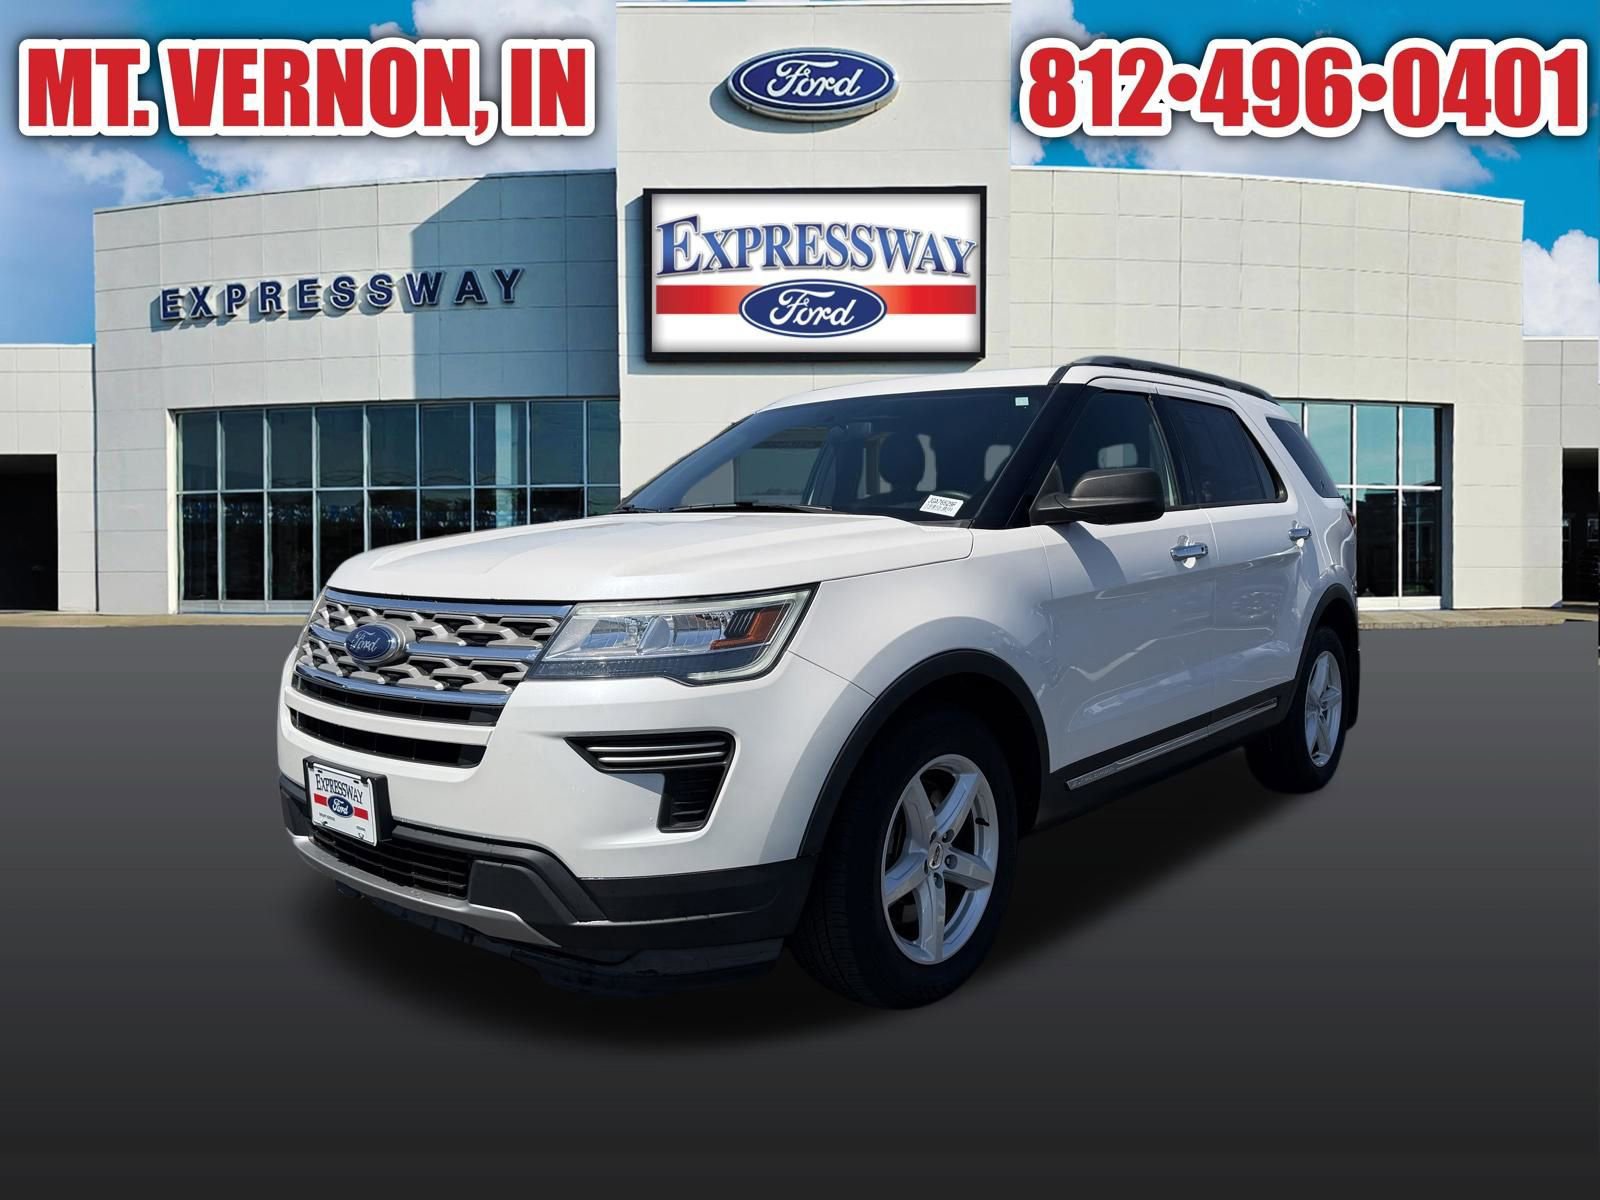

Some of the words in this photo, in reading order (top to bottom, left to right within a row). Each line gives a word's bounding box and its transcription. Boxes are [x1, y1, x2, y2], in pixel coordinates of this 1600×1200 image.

[767, 60, 863, 97] Ford
[656, 215, 976, 277] EXPRESSWAY
[160, 268, 524, 321] EXPRESSWAY
[769, 288, 857, 326] Ford
[350, 630, 381, 652] Ford
[315, 774, 363, 804] EXPRESSWAY
[332, 798, 349, 815] Ford
